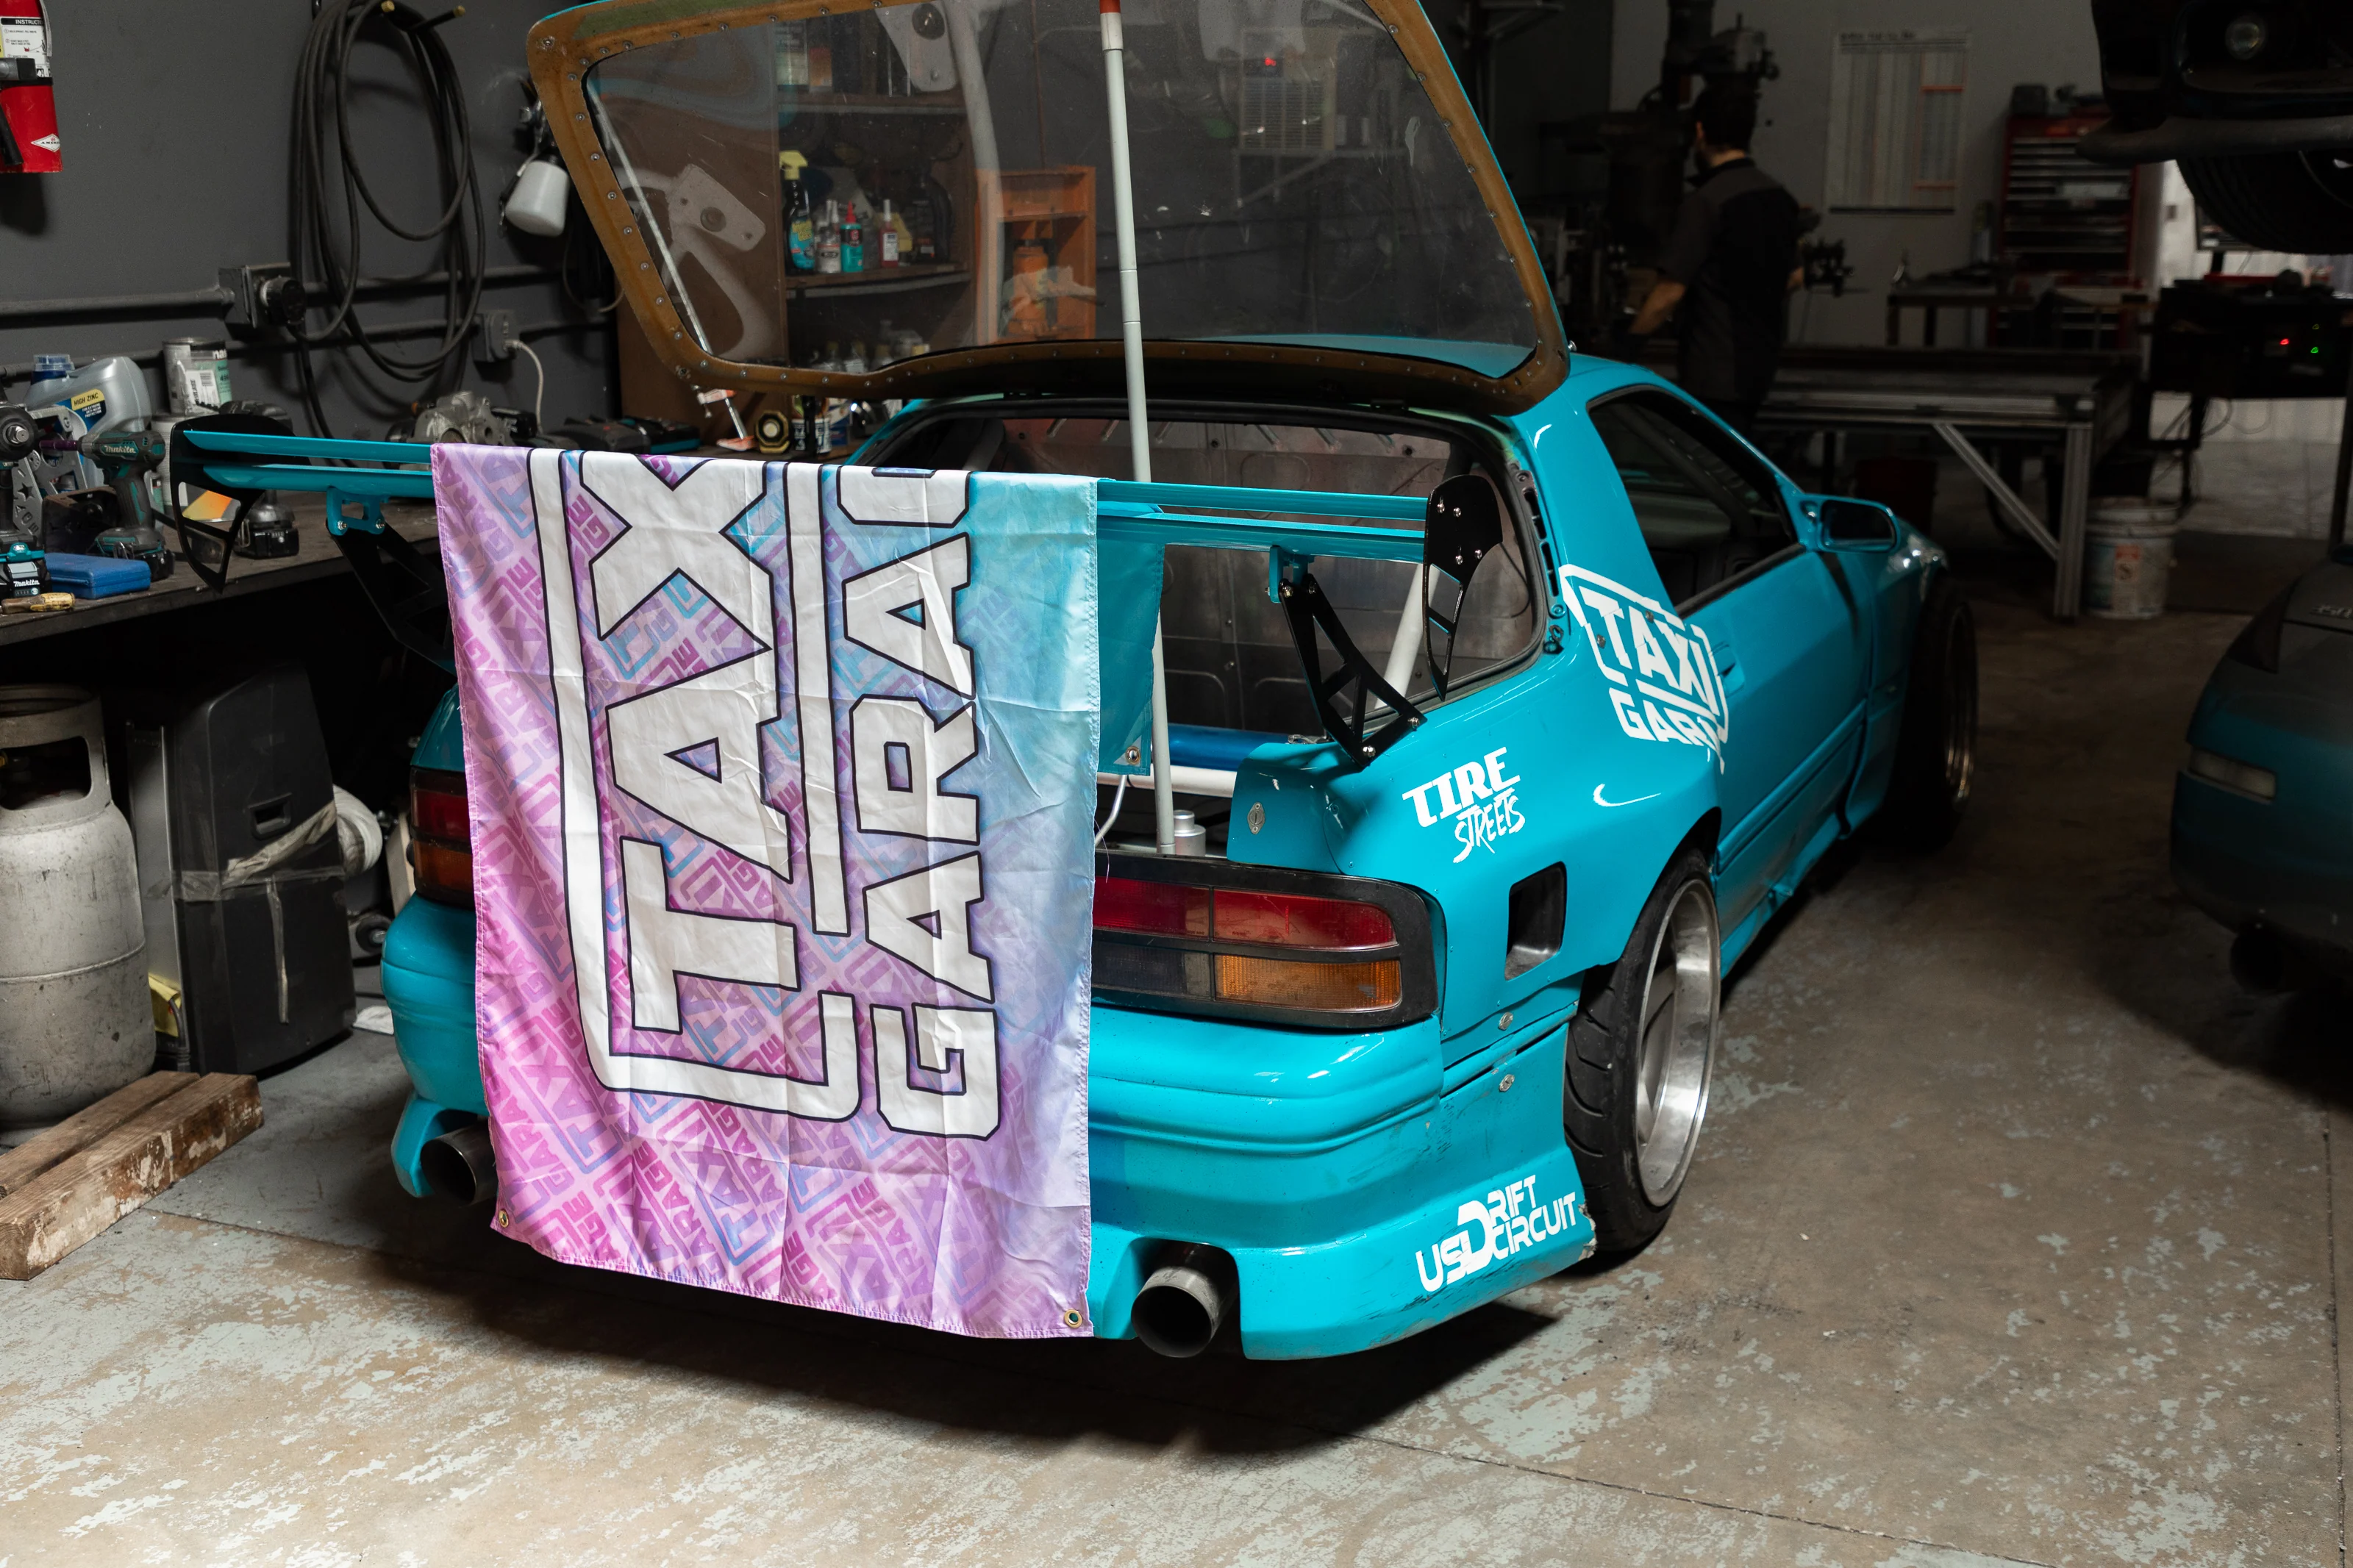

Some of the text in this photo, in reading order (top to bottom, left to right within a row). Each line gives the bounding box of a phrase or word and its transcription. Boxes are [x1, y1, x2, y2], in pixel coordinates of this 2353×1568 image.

[74, 393, 99, 406] HIGH ZINC
[1579, 586, 1720, 716] TAXI
[1402, 747, 1521, 828] TIRE
[1453, 787, 1526, 864] STREETS
[1492, 1192, 1576, 1260] CIRCUIT
